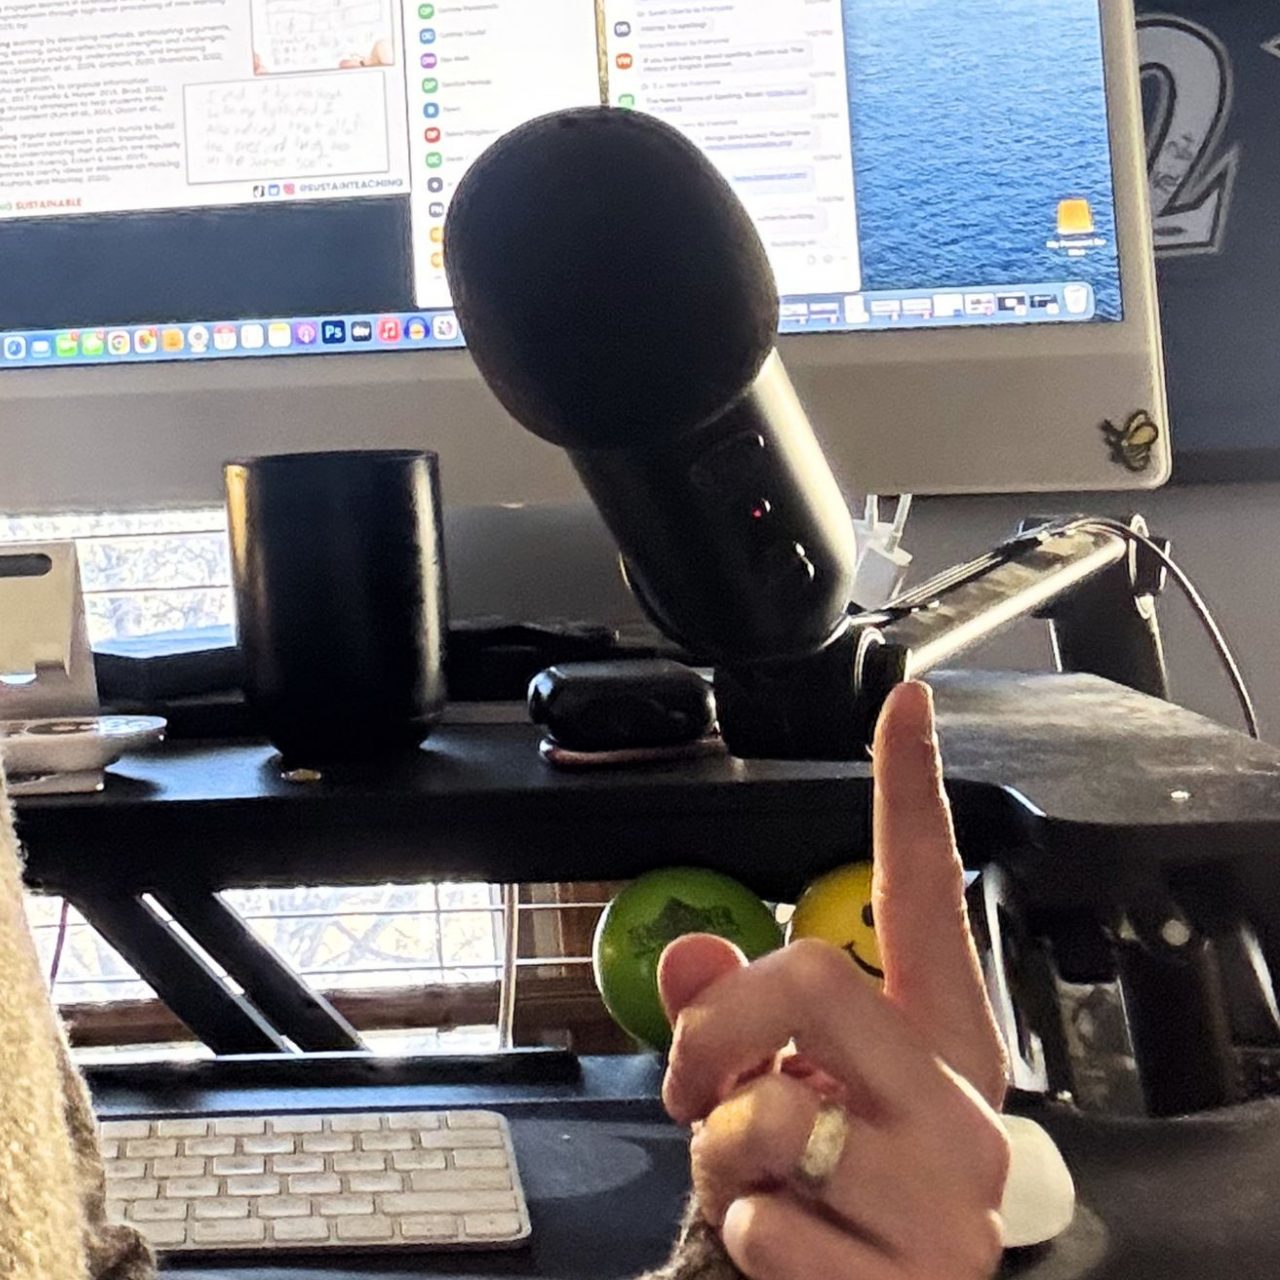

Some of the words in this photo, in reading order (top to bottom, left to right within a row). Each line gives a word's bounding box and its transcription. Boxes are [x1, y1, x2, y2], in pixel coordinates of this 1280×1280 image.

[1134, 11, 1280, 256] 2
[15, 197, 82, 211] SUSTAINABLE
[324, 324, 343, 339] Ps
